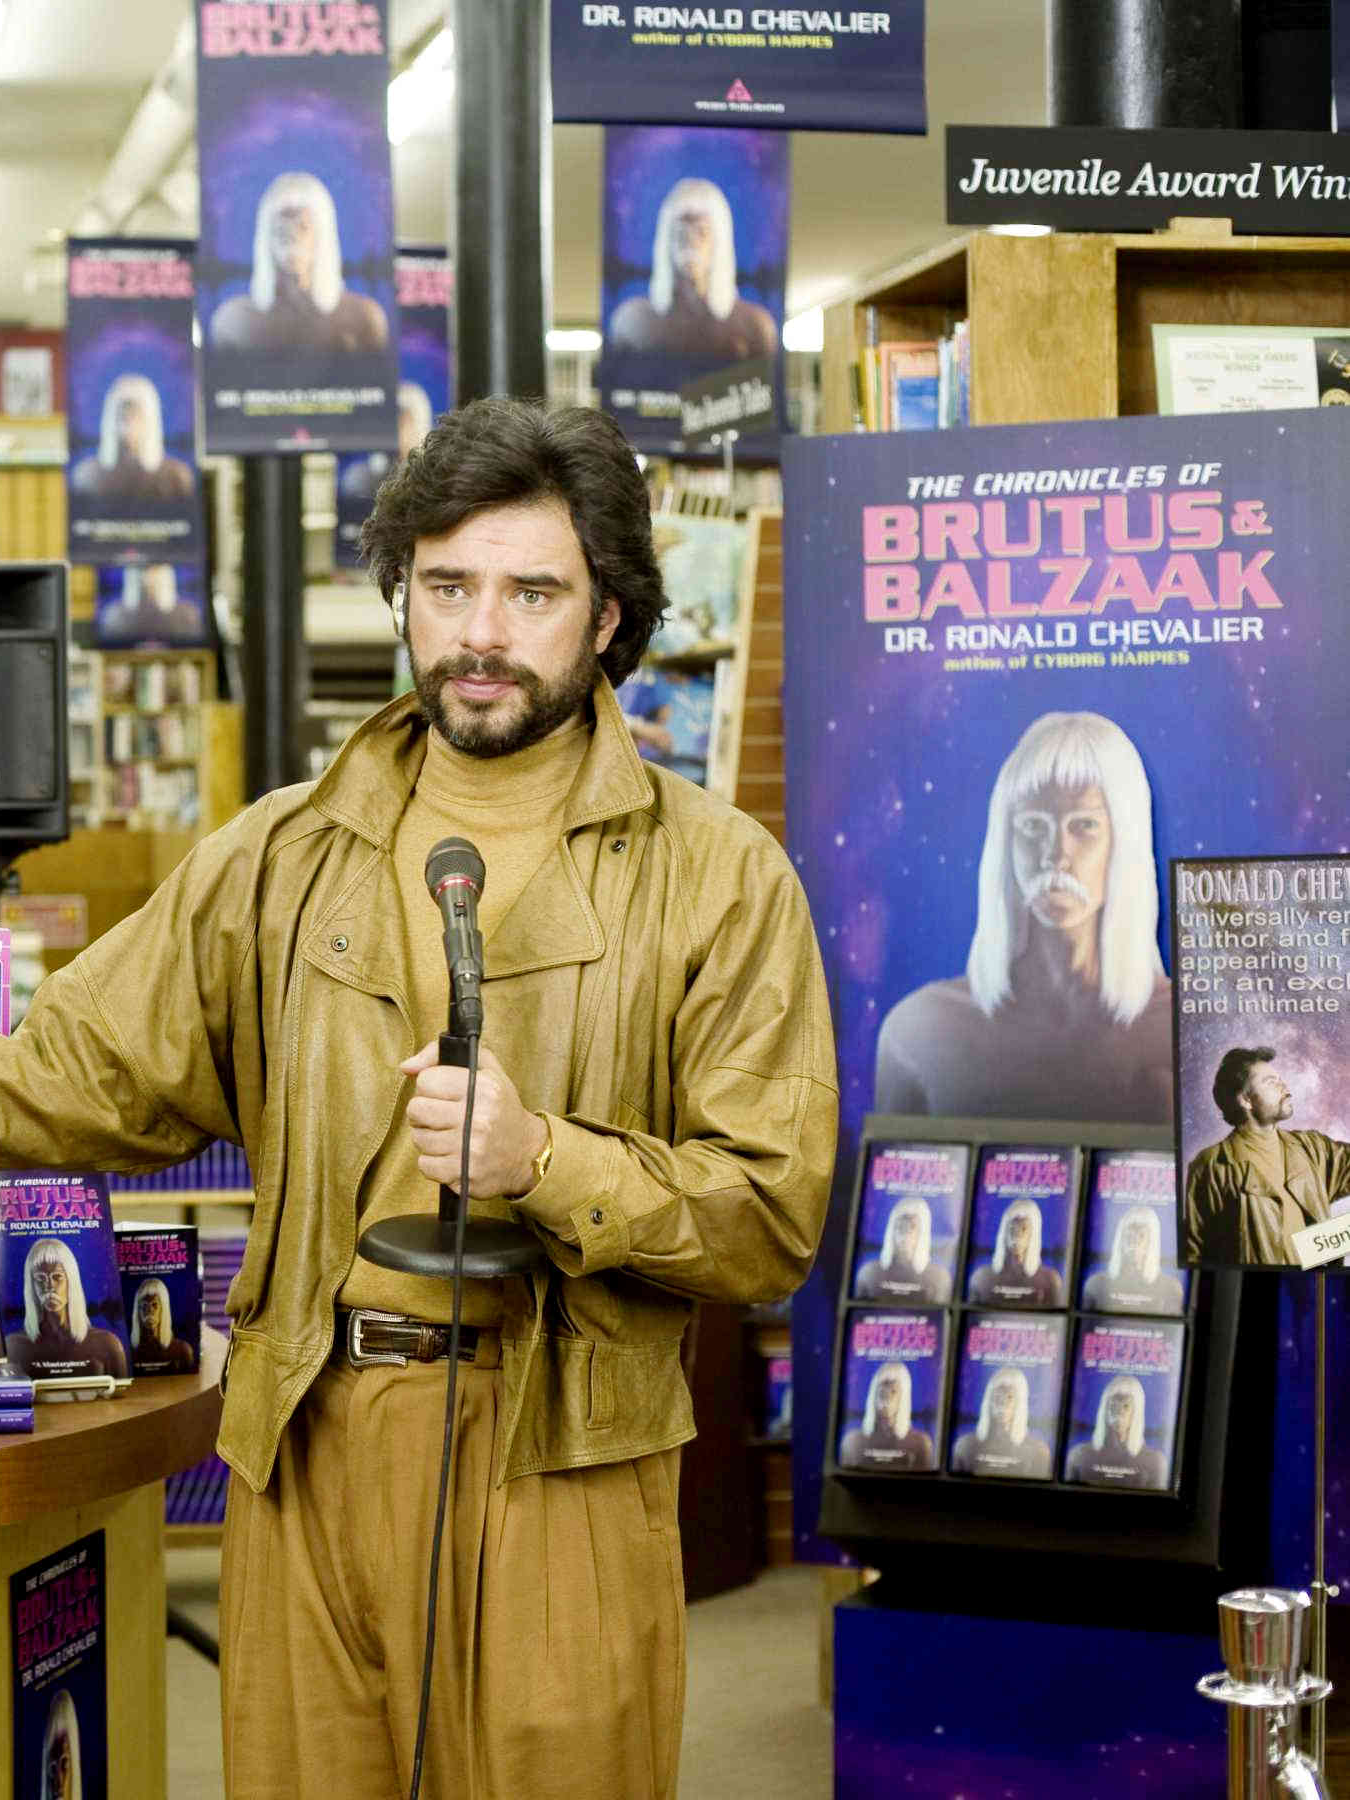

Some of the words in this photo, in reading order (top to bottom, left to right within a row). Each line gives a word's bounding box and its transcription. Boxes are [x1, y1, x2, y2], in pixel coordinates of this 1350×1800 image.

[582, 4, 626, 27] DR.
[634, 6, 744, 30] RONALD
[751, 9, 891, 34] CHEVALIER
[959, 158, 1120, 195] Juvenile
[1125, 162, 1261, 199] Award
[907, 474, 964, 499] THE
[973, 465, 1167, 497] CHRONICLES
[1177, 462, 1223, 487] OF
[862, 490, 1224, 564] BRUTUS
[863, 549, 1285, 623] BALZAAK
[884, 627, 935, 653] DR.
[946, 622, 1078, 652] RONALD
[1089, 616, 1265, 647] CHEVALIER
[1033, 653, 1106, 671] CYBORG
[1110, 650, 1191, 668] HARPIES
[1181, 868, 1284, 904] RONALD
[1180, 907, 1309, 929] universally
[1181, 930, 1269, 948] author
[1279, 929, 1329, 947] and
[1181, 951, 1307, 973] appearing
[1319, 951, 1340, 968] in
[1181, 973, 1224, 992] for
[1236, 976, 1274, 991] an
[1182, 995, 1228, 1013] and
[1238, 995, 1339, 1012] intimate
[14, 1178, 69, 1187] CHRONICLES
[71, 1177, 84, 1185] OF
[10, 1221, 50, 1230] RONALD
[51, 1220, 100, 1229] CHEVALIER
